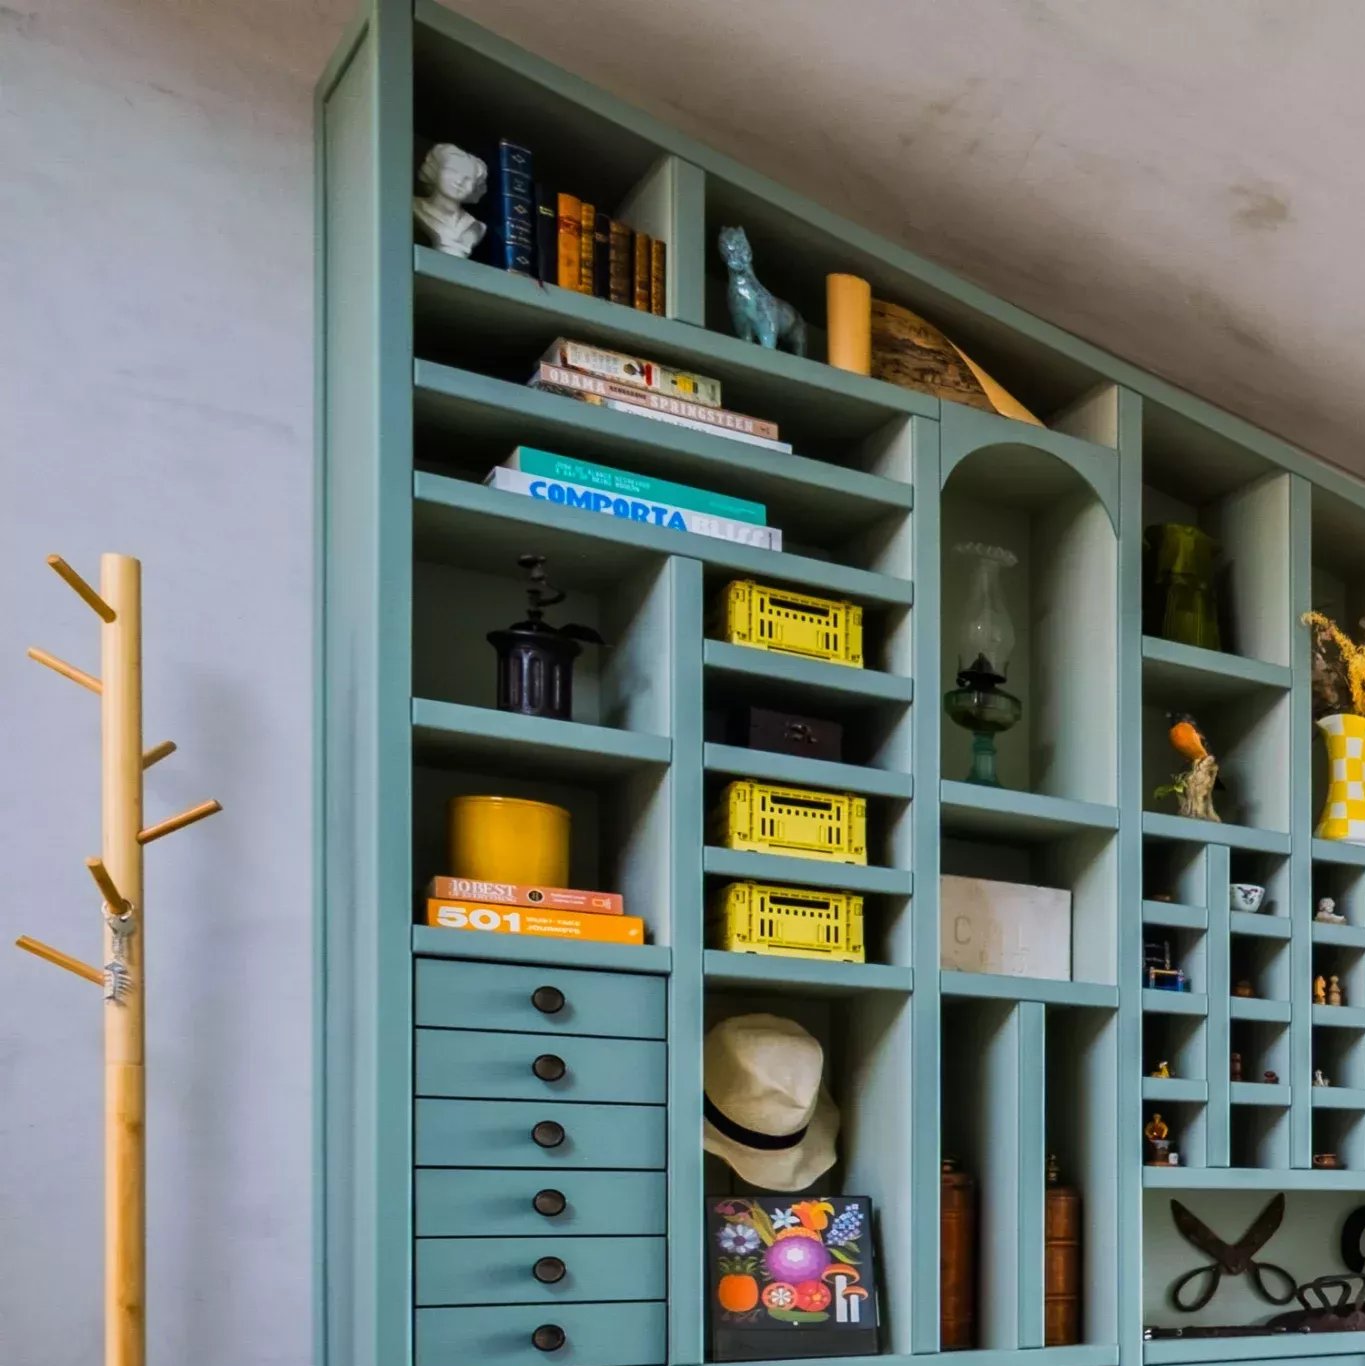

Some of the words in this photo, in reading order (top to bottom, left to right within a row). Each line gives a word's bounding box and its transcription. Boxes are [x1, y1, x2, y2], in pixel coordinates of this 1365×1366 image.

[550, 367, 606, 395] OBAMA
[650, 398, 754, 433] SPRINGSTEEN
[529, 480, 688, 532] COMPORTA
[451, 879, 470, 894] 10
[471, 881, 517, 897] BEST
[437, 905, 521, 933] 501
